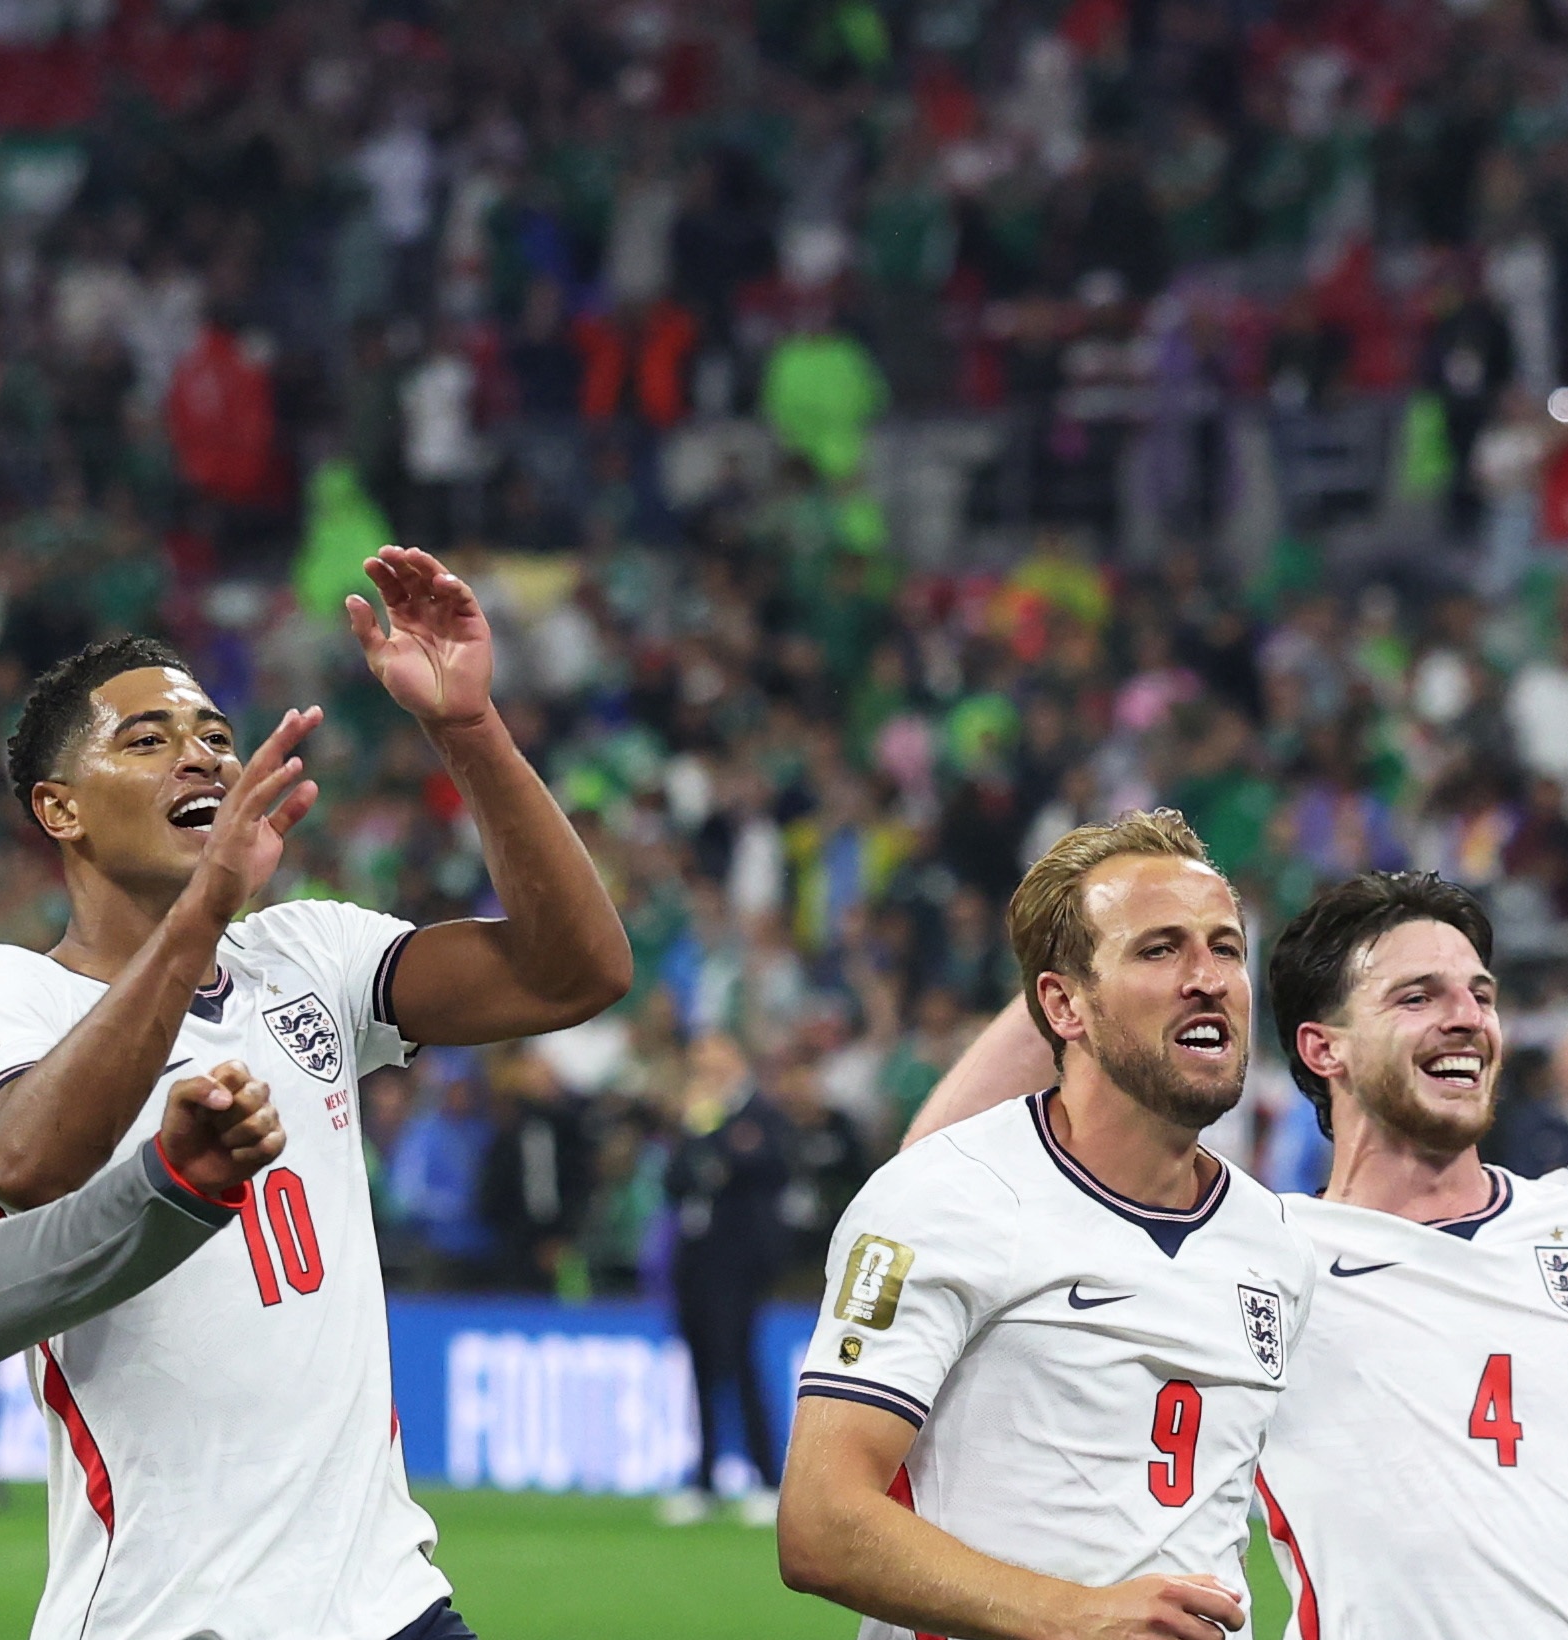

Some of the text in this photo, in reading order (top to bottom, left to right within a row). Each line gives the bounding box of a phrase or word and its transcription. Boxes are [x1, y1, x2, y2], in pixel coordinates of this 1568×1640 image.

[325, 1089, 347, 1110] MEXI
[240, 1166, 325, 1307] 10
[1148, 1379, 1202, 1508] 9
[1468, 1354, 1523, 1467] 4
